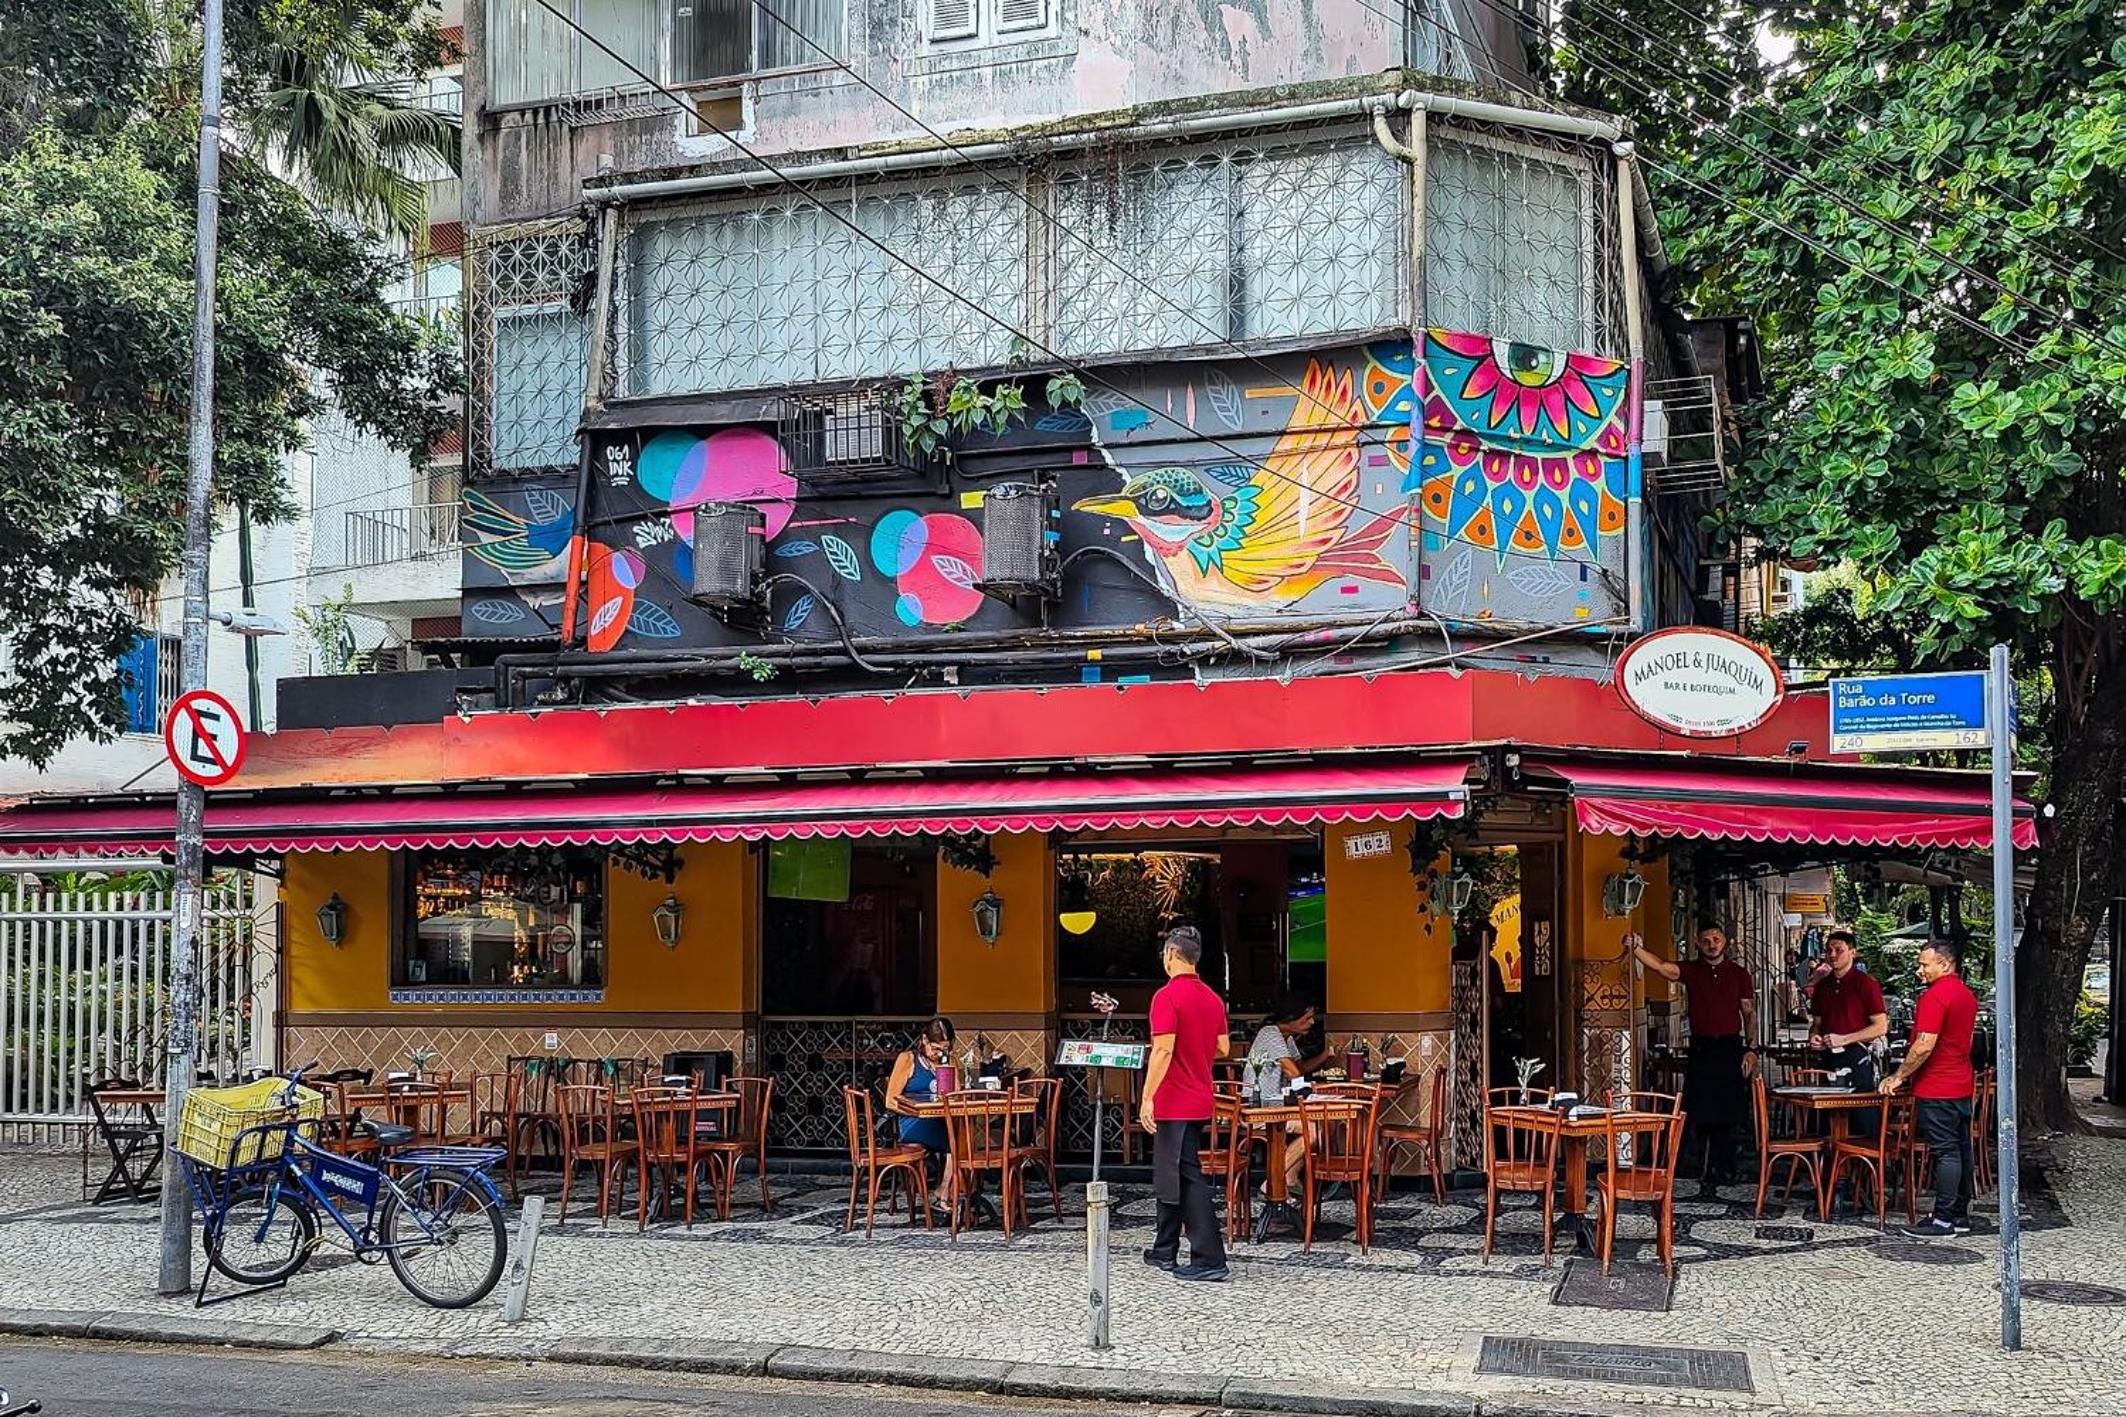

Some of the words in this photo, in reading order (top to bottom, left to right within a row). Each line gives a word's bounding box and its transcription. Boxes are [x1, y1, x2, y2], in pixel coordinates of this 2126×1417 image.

[606, 444, 629, 460] 061
[608, 461, 634, 476] INK
[1634, 651, 1689, 686] MANOEL
[1692, 651, 1702, 668] &
[1663, 681, 1680, 691] BAR
[1683, 682, 1687, 691] E
[1690, 683, 1736, 696] BOTEQUIM
[1839, 683, 1863, 695] Rua
[1839, 694, 1876, 708] Barão
[1879, 694, 1896, 706] da
[1901, 692, 1936, 705] Torre
[1839, 736, 1863, 749] 240
[1955, 732, 1979, 745] 162
[1353, 838, 1384, 852] 162
